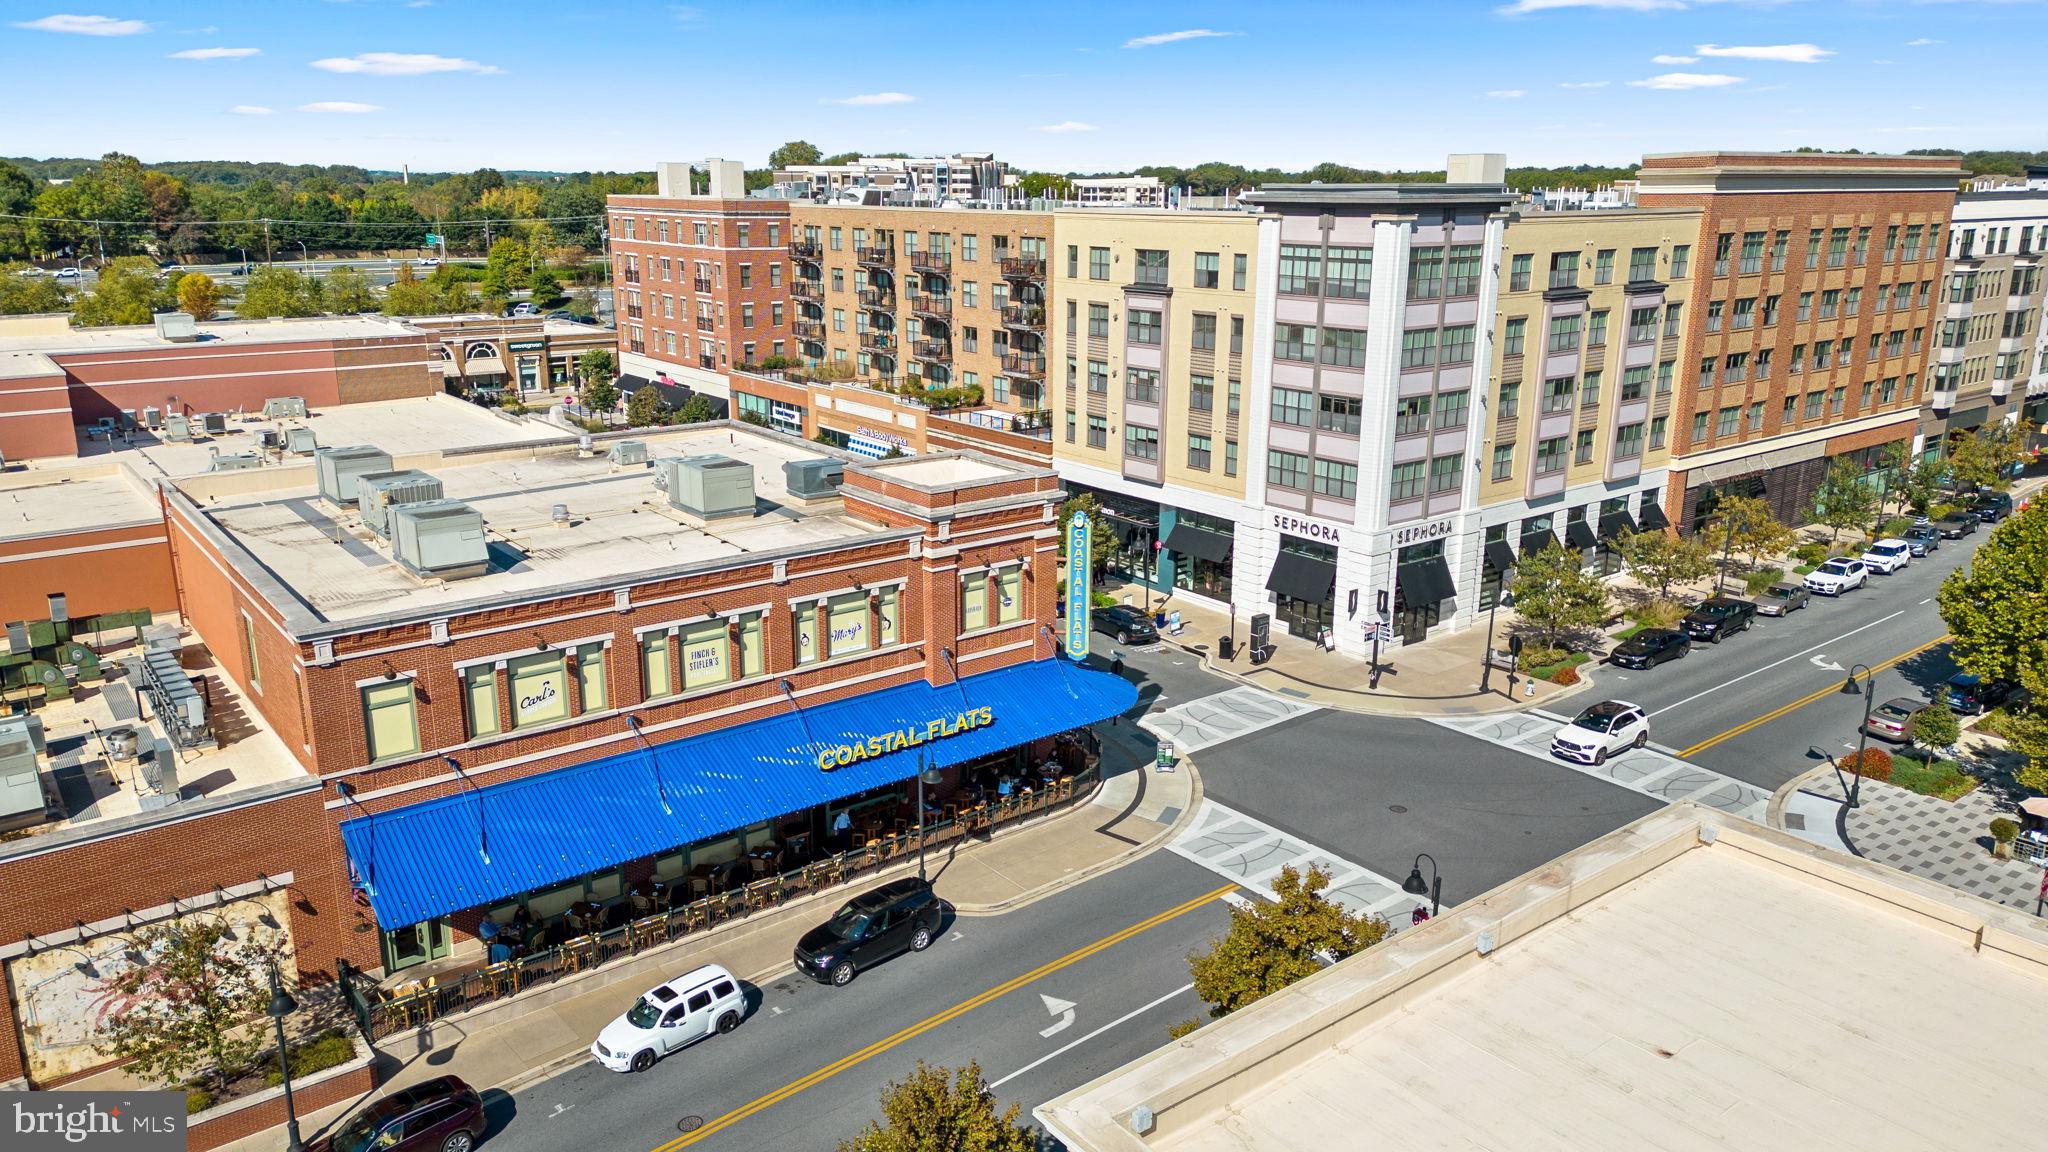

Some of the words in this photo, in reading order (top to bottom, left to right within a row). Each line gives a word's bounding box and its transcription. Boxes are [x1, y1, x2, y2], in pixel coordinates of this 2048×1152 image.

[1274, 515, 1340, 542] SEPHORA
[1397, 520, 1452, 544] SEPHORA
[1073, 528, 1084, 597] COASTAL
[1073, 601, 1083, 650] FLATS
[689, 657, 719, 671] STIFLER'S
[691, 648, 710, 660] FINCH
[521, 687, 556, 709] Carl's
[818, 726, 923, 771] COASTAL
[927, 706, 992, 740] FLATS
